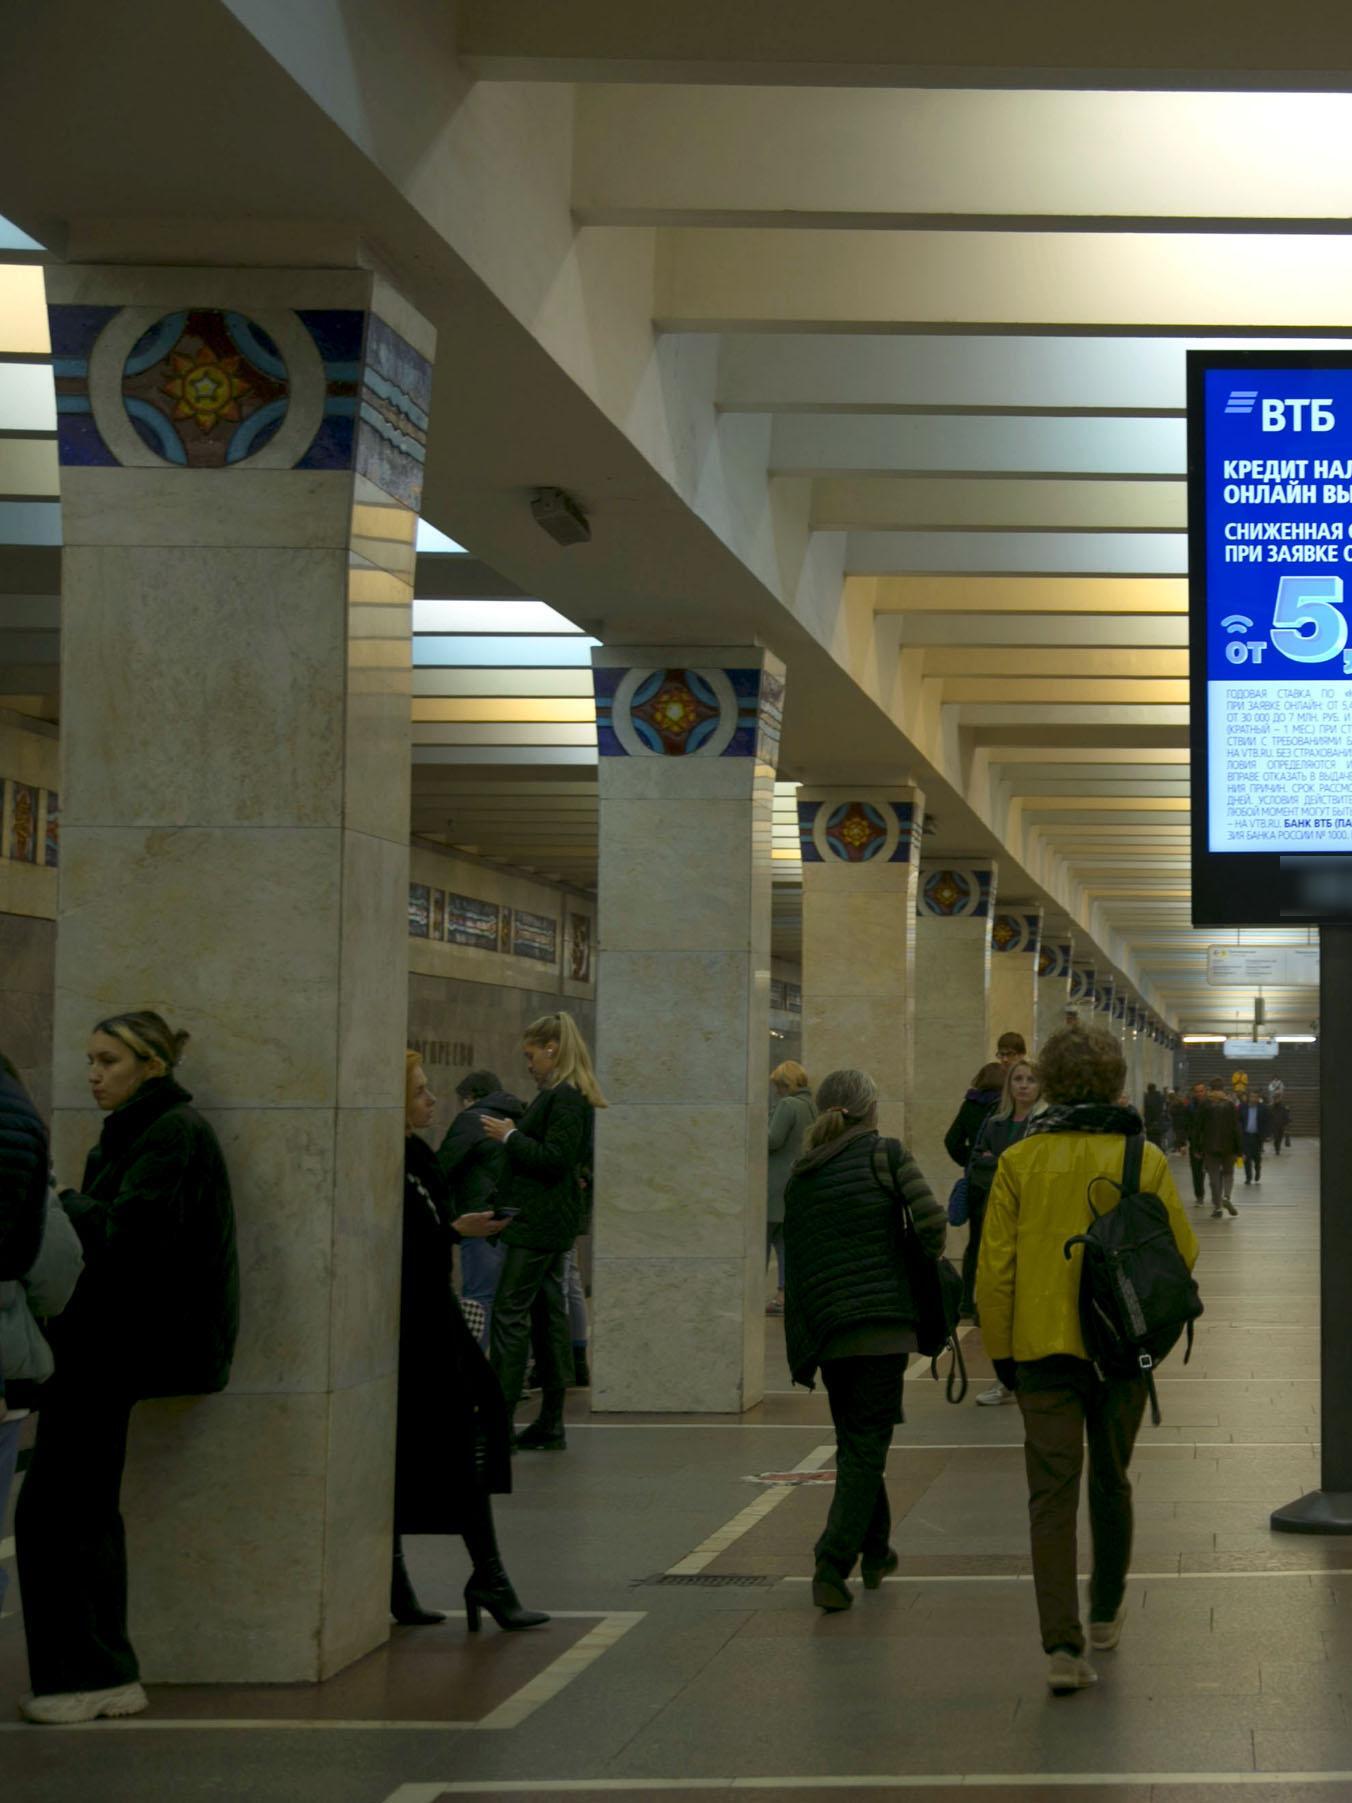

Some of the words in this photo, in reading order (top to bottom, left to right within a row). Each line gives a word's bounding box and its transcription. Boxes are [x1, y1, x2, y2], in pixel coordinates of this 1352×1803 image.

[1261, 398, 1336, 432] ВТБ
[1223, 460, 1309, 483] КРЕДИТ
[1223, 481, 1317, 504] ОНЛАЙН
[1224, 522, 1343, 540] СНИЖЕННАЯ
[1225, 544, 1262, 562] ПРИ
[1267, 544, 1339, 562] ЗАЯВКЕ
[1277, 688, 1311, 699] СТАВКА
[1321, 688, 1335, 699] ПО
[1226, 700, 1245, 711] ПРИ
[1248, 700, 1281, 711] ЗАЯВКЕ
[1328, 700, 1339, 711] ОТ
[1226, 712, 1238, 722] ОТ
[1241, 712, 1252, 722] 30
[1254, 712, 1270, 722] 000
[1272, 712, 1286, 722] ДО
[1289, 712, 1295, 722] 7
[1344, 712, 1351, 722] И
[1319, 724, 1337, 734] ПРИ
[1227, 736, 1256, 746] СТВИИ
[1261, 736, 1267, 746] С
[1272, 736, 1342, 746] ТРЕБОВАНИЯМИ
[1227, 748, 1240, 758] НА
[1277, 748, 1291, 758] БЕЗ
[1227, 759, 1257, 770] ЛОВИЯ
[1227, 771, 1260, 781] ВПРАВЕ
[1262, 771, 1308, 781] ОТКАЗАТЬ
[1311, 771, 1316, 781] В
[1227, 783, 1246, 793] НИЯ
[1292, 783, 1314, 793] СРОК
[1258, 794, 1299, 805] УСЛОВИЯ
[1261, 806, 1300, 817] МОМЕНТ
[1301, 806, 1330, 817] МОГУТ
[1284, 818, 1312, 828] БАНК
[1314, 818, 1333, 828] ВТБ
[1247, 830, 1277, 840] БАНКА
[1279, 830, 1314, 840] РОССИИ
